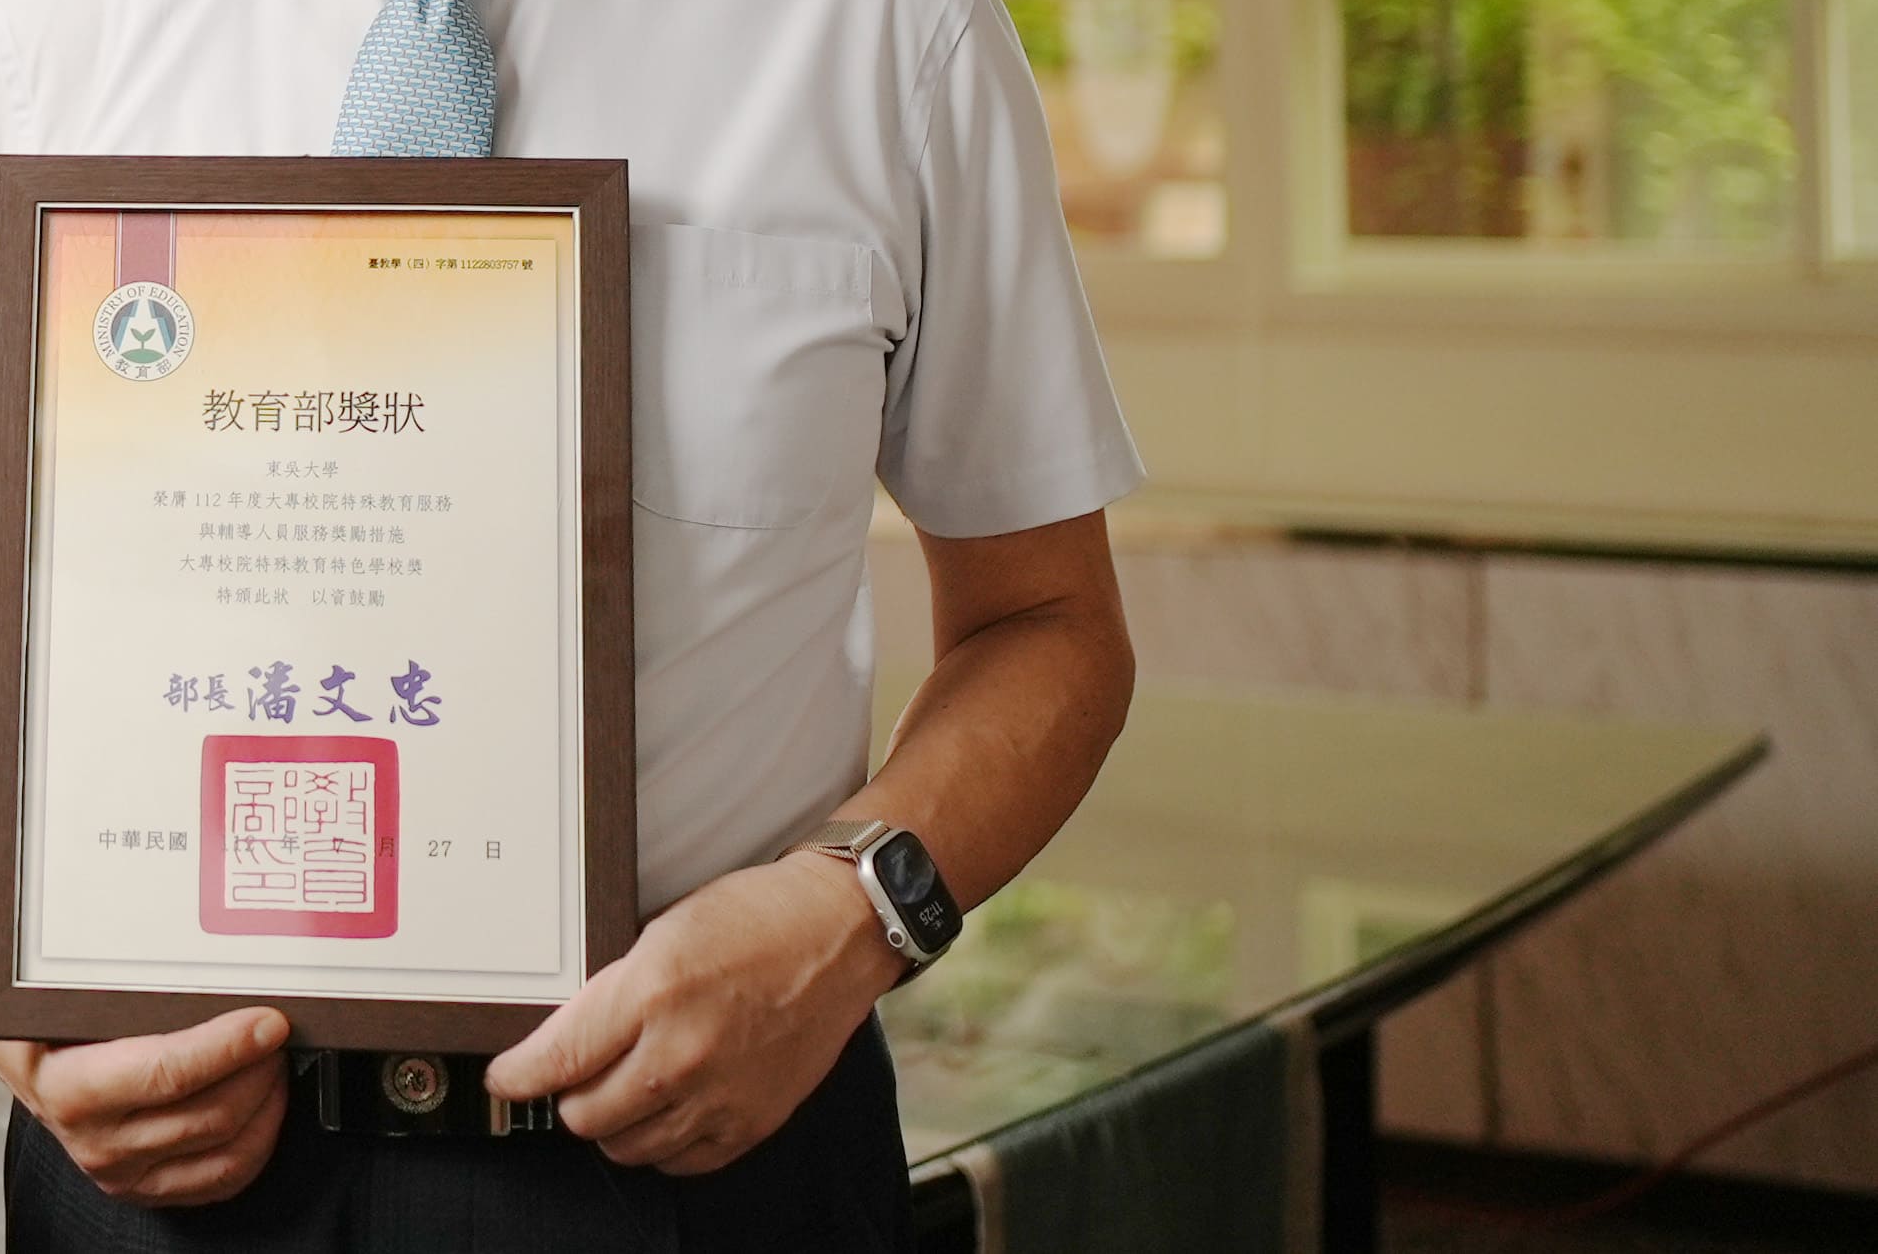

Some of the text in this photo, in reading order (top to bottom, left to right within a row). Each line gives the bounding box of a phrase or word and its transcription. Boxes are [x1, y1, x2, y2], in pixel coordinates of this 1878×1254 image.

[97, 285, 190, 358] MINISTRY OF EDUCATION
[114, 357, 172, 379] 教育部
[200, 387, 426, 436] 教育部獎狀
[265, 460, 339, 479] 東吳大學
[162, 659, 443, 727] 部長 潘文忠
[98, 828, 189, 853] 中華民國
[426, 840, 453, 859] 27
[485, 840, 502, 861] 日
